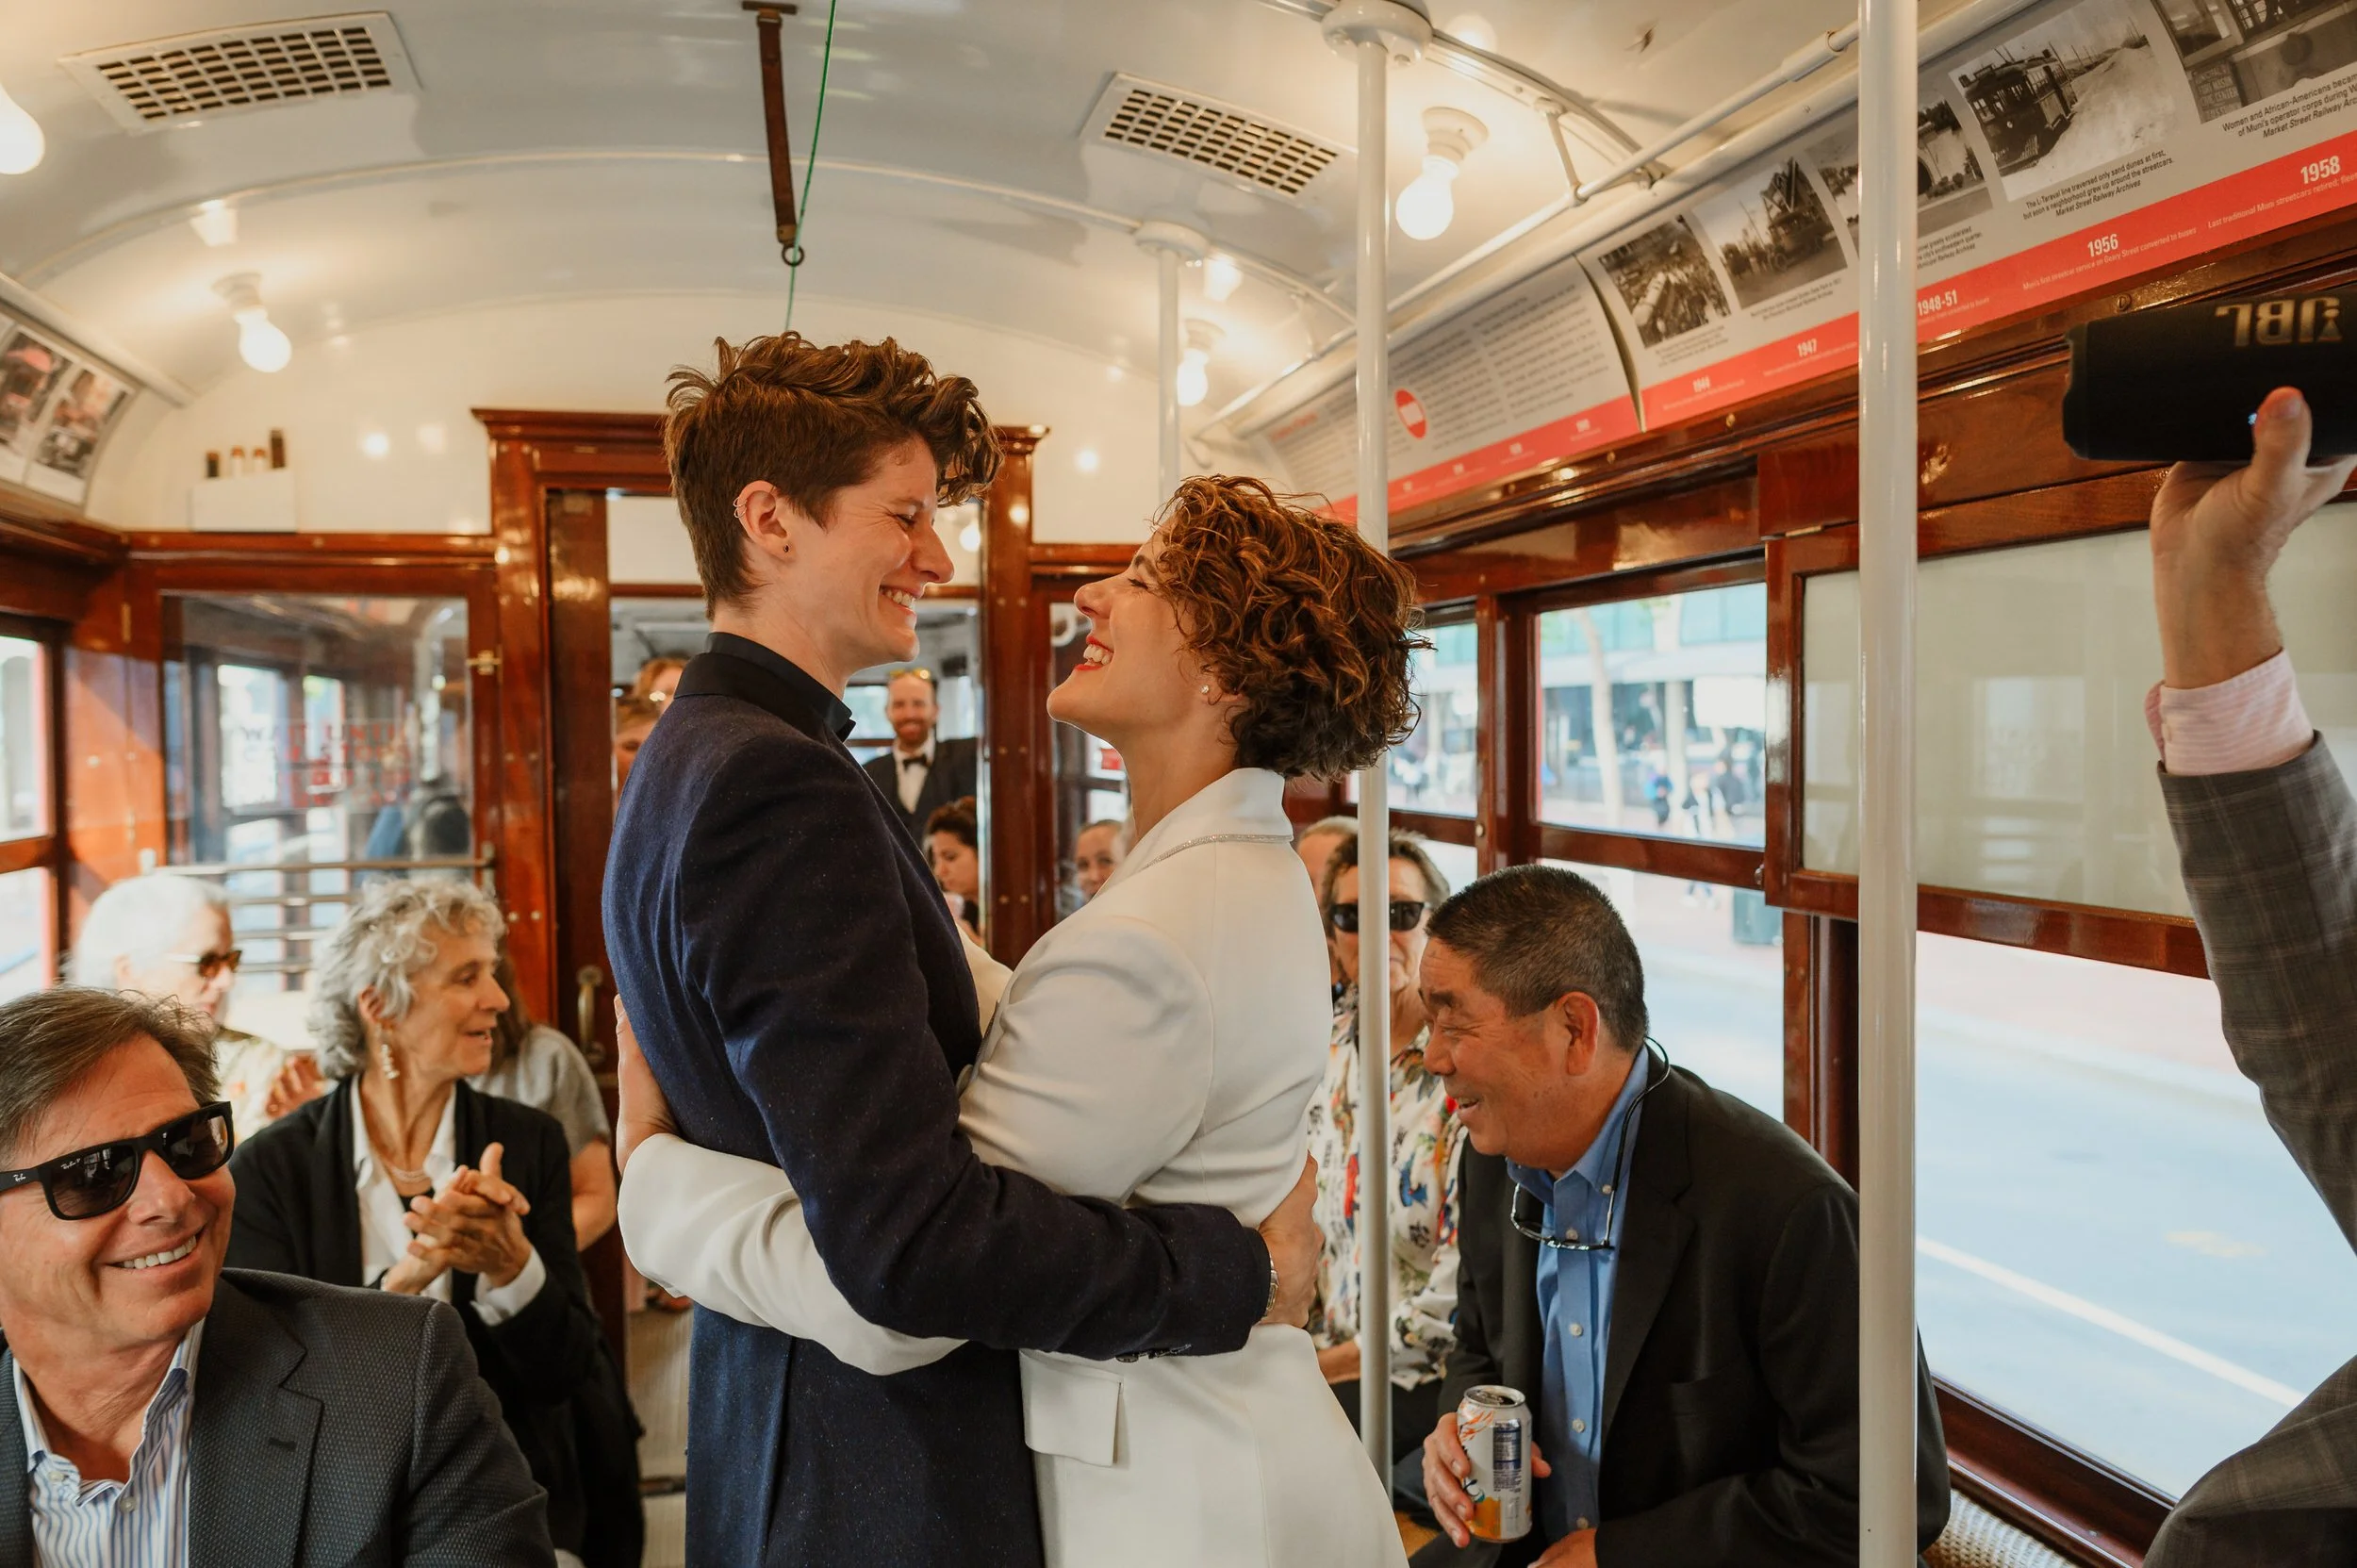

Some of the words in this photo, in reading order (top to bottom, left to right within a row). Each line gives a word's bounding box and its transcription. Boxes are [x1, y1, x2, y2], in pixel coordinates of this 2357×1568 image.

[2222, 117, 2249, 131] Women
[2250, 109, 2263, 121] and
[2264, 85, 2331, 115] African-Americans
[2238, 128, 2245, 137] of
[2246, 120, 2268, 133] Muni's
[2270, 107, 2300, 125] operator
[2302, 99, 2323, 113] corps
[2324, 89, 2348, 103] during
[2264, 123, 2288, 138] Market
[2290, 113, 2312, 128] Street
[2313, 104, 2341, 120] Railway
[2033, 207, 2045, 218] soon
[2051, 190, 2086, 210] neighborhood
[2087, 185, 2102, 197] grew
[2102, 181, 2110, 190] up
[2111, 173, 2131, 186] around
[2131, 168, 2141, 177] the
[2142, 157, 2173, 173] streetcars.
[2061, 187, 2071, 195] line
[2071, 176, 2098, 192] traversed
[2099, 172, 2111, 183] only
[2111, 166, 2125, 176] sand
[2126, 158, 2144, 170] dunes
[2151, 150, 2167, 159] first,
[2300, 156, 2341, 185] 1958
[2055, 205, 2075, 218] Market
[2076, 198, 2092, 210] Street
[2093, 190, 2115, 205] Railway
[2116, 180, 2141, 194] Archives
[2208, 219, 2222, 229] Last
[2223, 206, 2256, 223] traditional
[2276, 188, 2312, 205] streetcars
[2087, 233, 2118, 257] 1956
[2104, 253, 2120, 264] Geary
[2121, 246, 2139, 257] Street
[2140, 236, 2169, 251] converted
[1918, 289, 1958, 316] 1948-51
[2216, 296, 2341, 347] JBL
[1797, 338, 1818, 358] 1947
